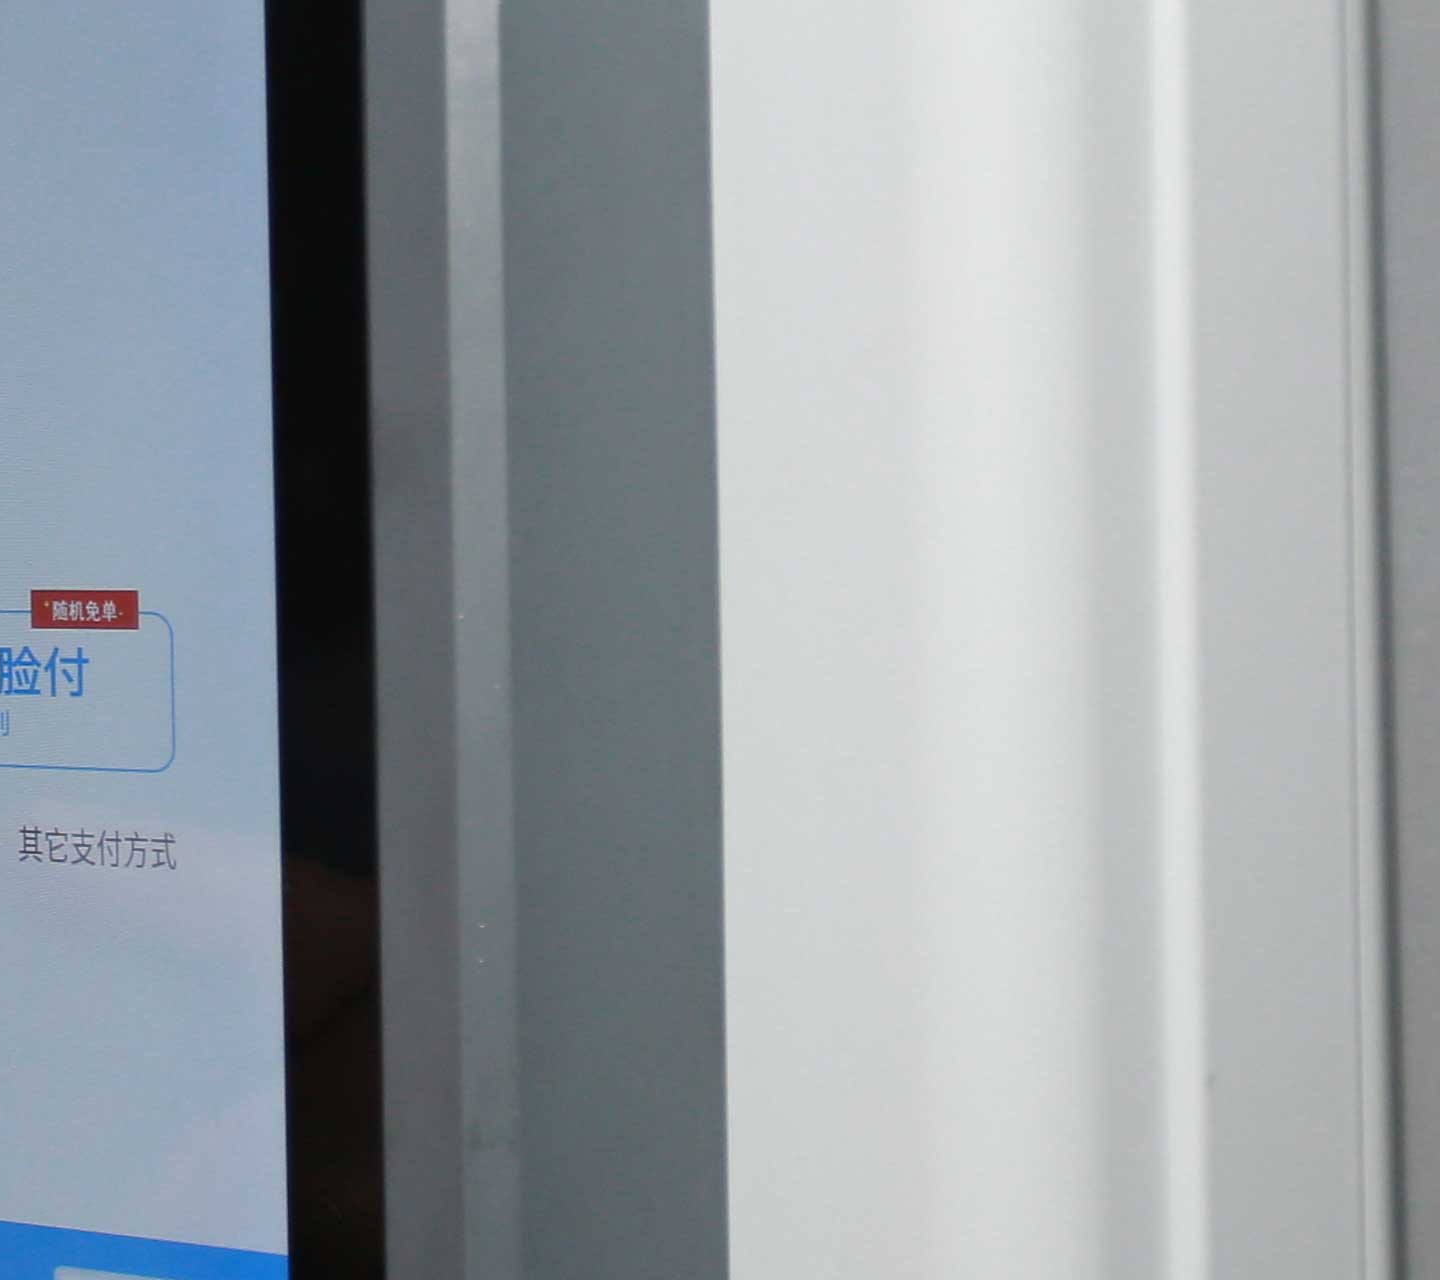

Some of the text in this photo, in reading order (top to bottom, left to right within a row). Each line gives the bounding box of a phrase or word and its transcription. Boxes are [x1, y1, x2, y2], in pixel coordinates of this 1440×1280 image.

[51, 599, 118, 623] 随机免单
[18, 824, 178, 871] 其它支付方式
